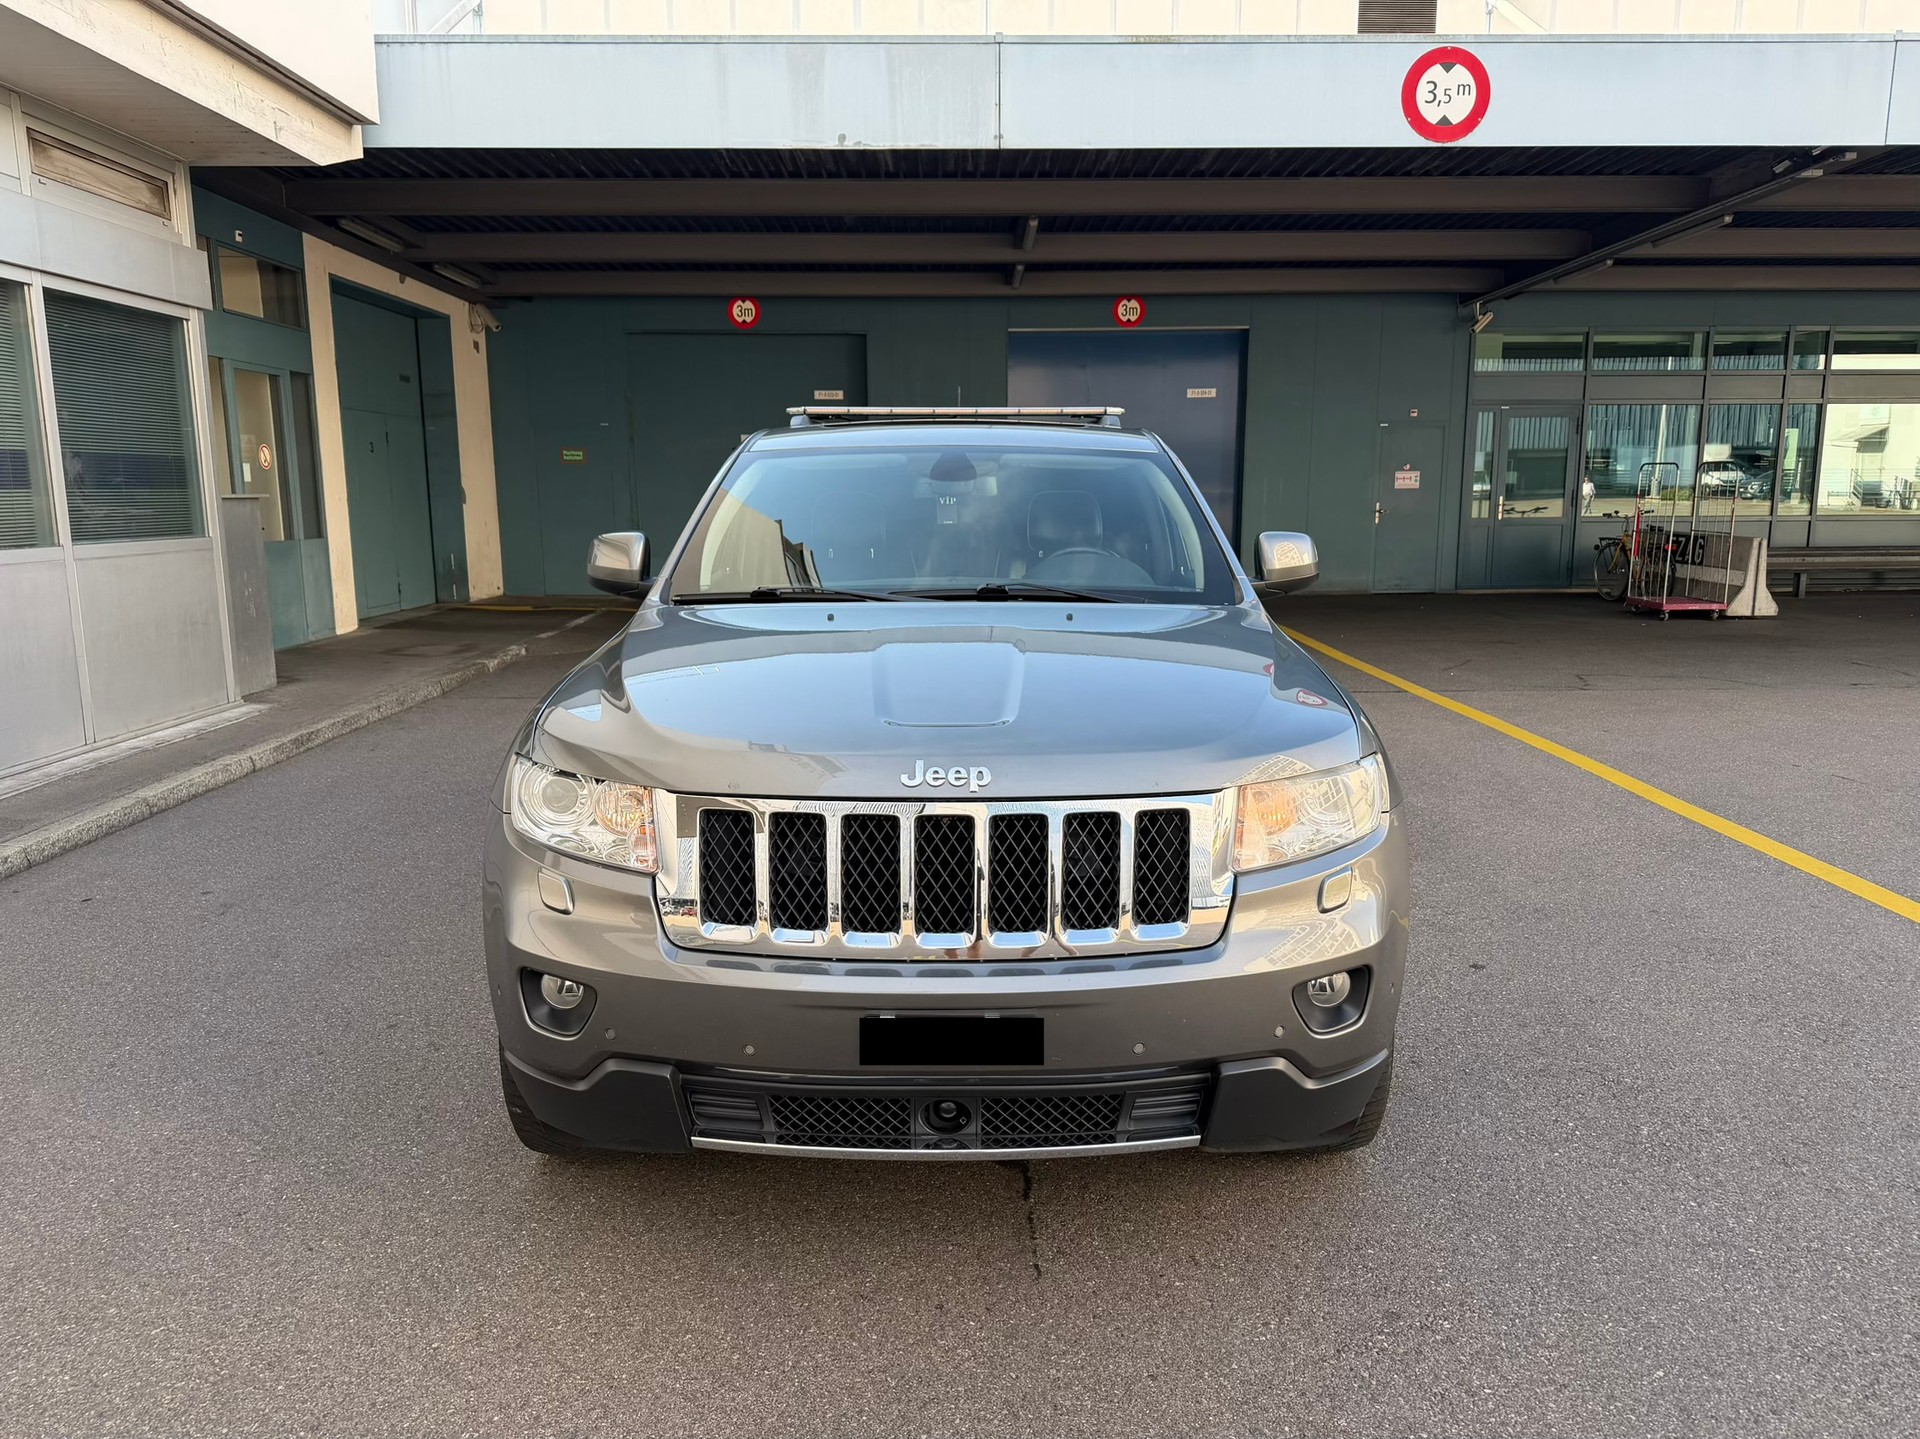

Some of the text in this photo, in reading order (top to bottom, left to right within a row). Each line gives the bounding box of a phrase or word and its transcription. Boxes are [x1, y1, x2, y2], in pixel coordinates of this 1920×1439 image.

[1424, 80, 1452, 107] 3,5
[736, 304, 754, 318] 3m
[1121, 303, 1139, 317] 3m
[369, 441, 374, 453] 3
[900, 759, 992, 793] Jeep
